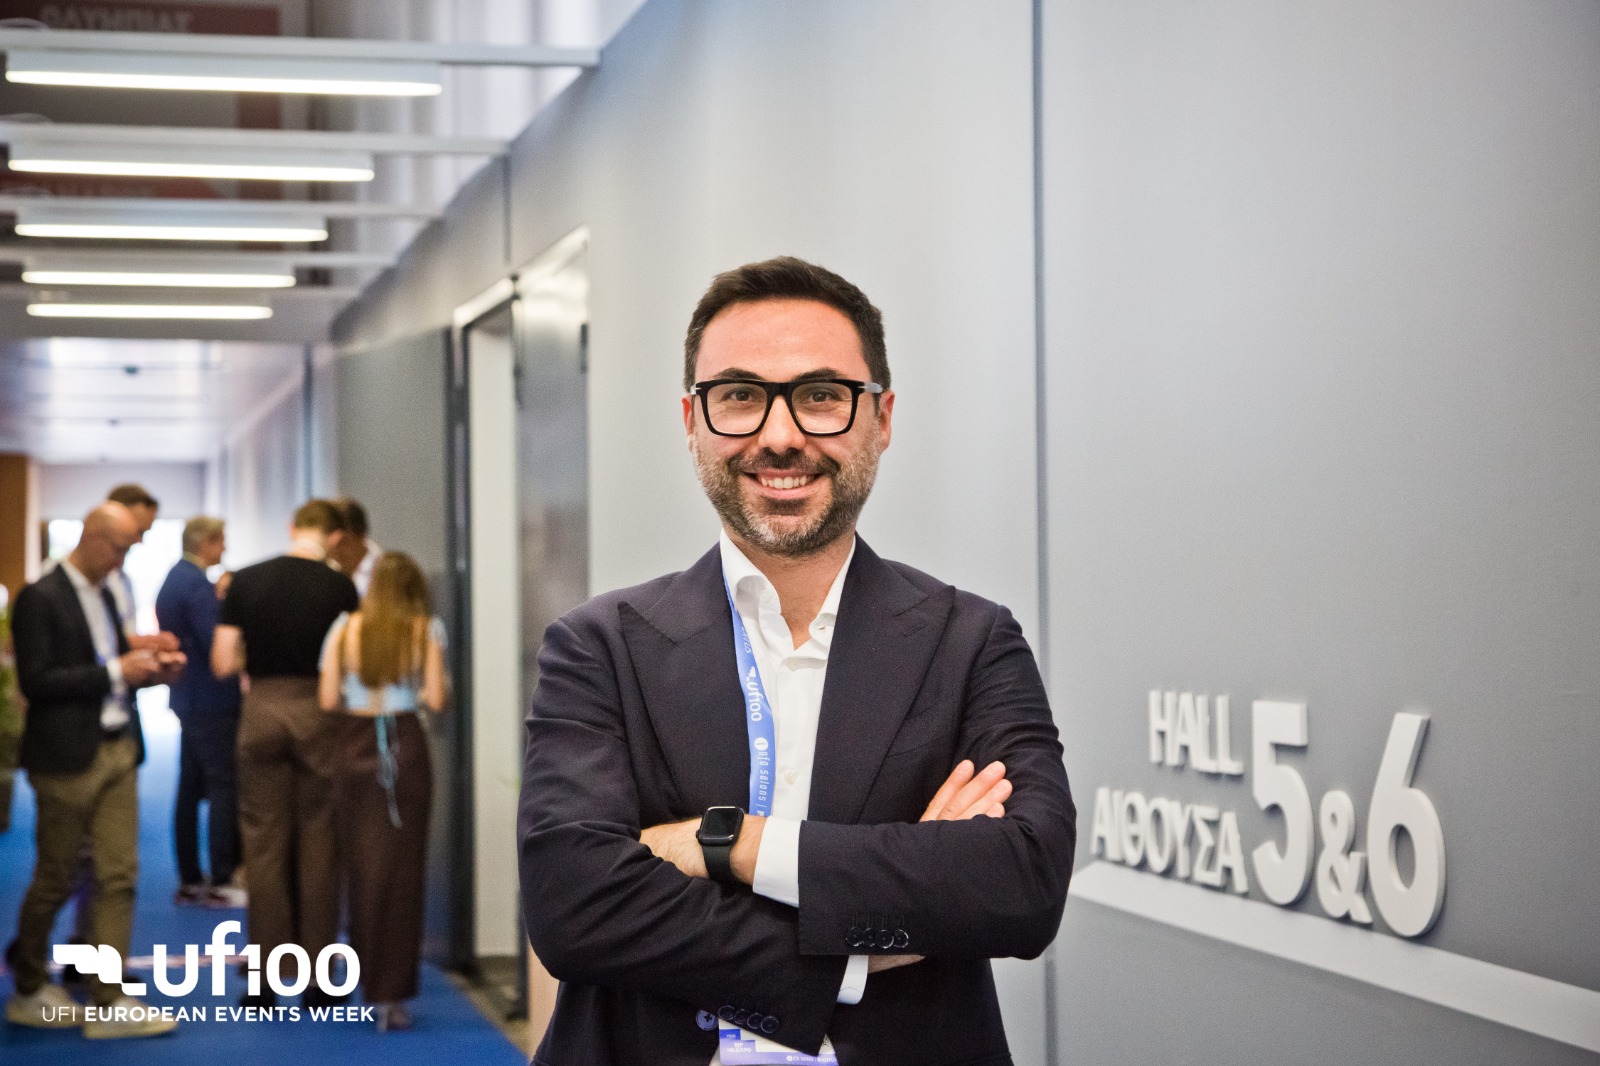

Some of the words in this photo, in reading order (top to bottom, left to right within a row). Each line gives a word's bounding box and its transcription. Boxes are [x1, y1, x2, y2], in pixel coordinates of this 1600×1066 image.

[1148, 689, 1244, 776] HALL
[757, 769, 770, 802] salons
[1089, 786, 1249, 894] ΑΙΘΟΥΣΑ
